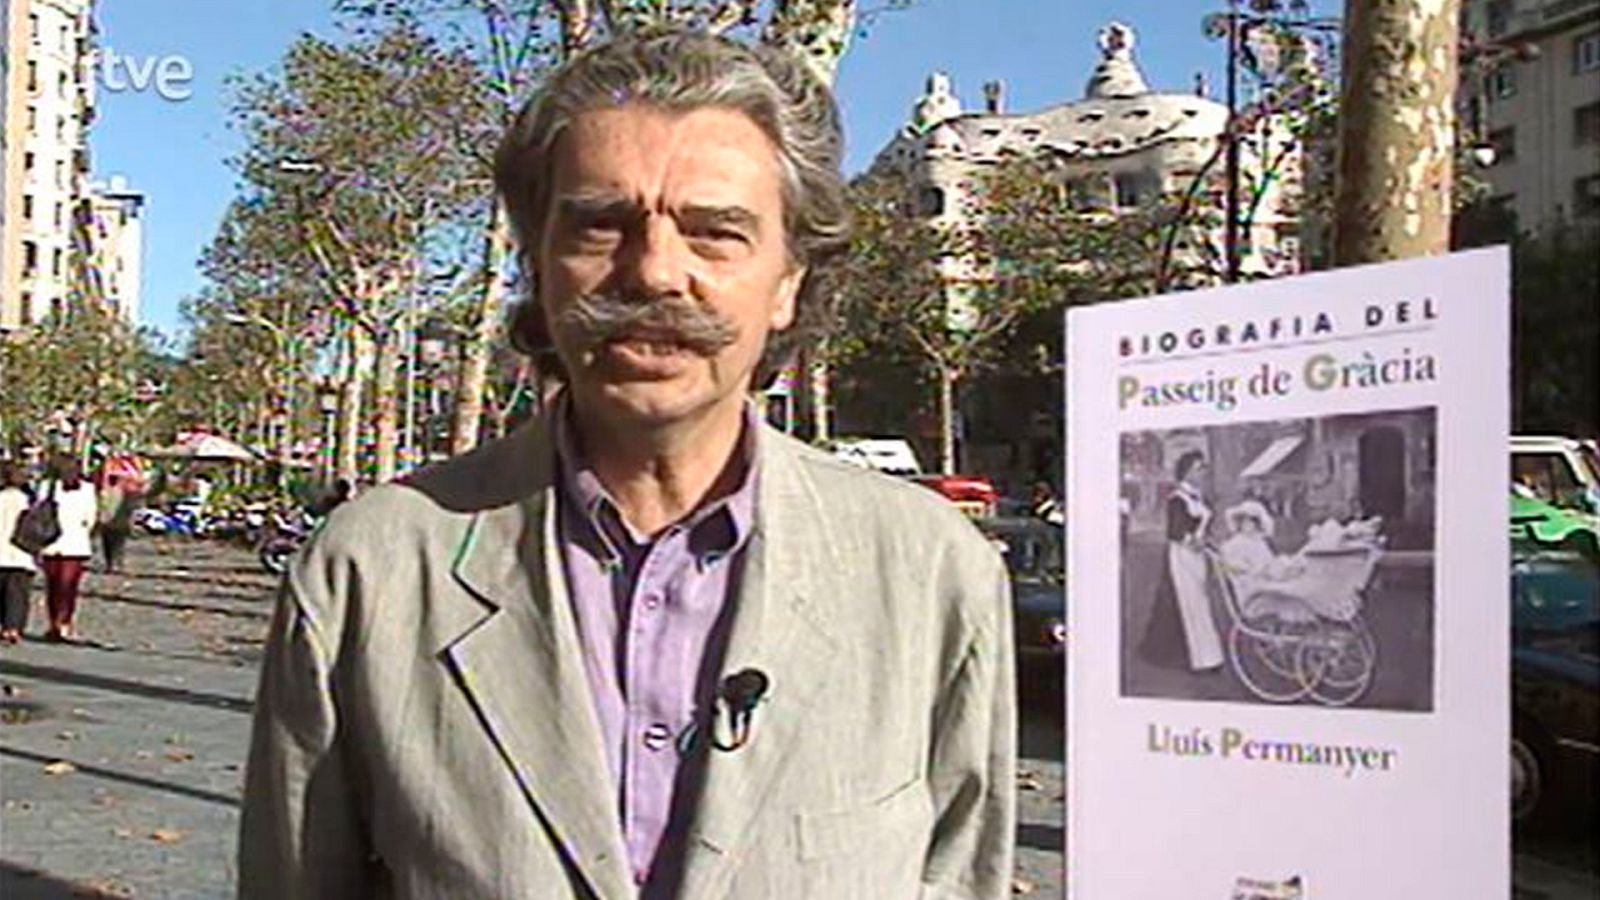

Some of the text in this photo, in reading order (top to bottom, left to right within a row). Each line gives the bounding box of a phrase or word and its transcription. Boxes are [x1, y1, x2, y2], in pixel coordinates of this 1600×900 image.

[1119, 298, 1438, 356] BIOGRAFIA DEL
[1118, 349, 1437, 411] Passeig de Gràcia
[1147, 723, 1396, 777] Lluís Permanyer
